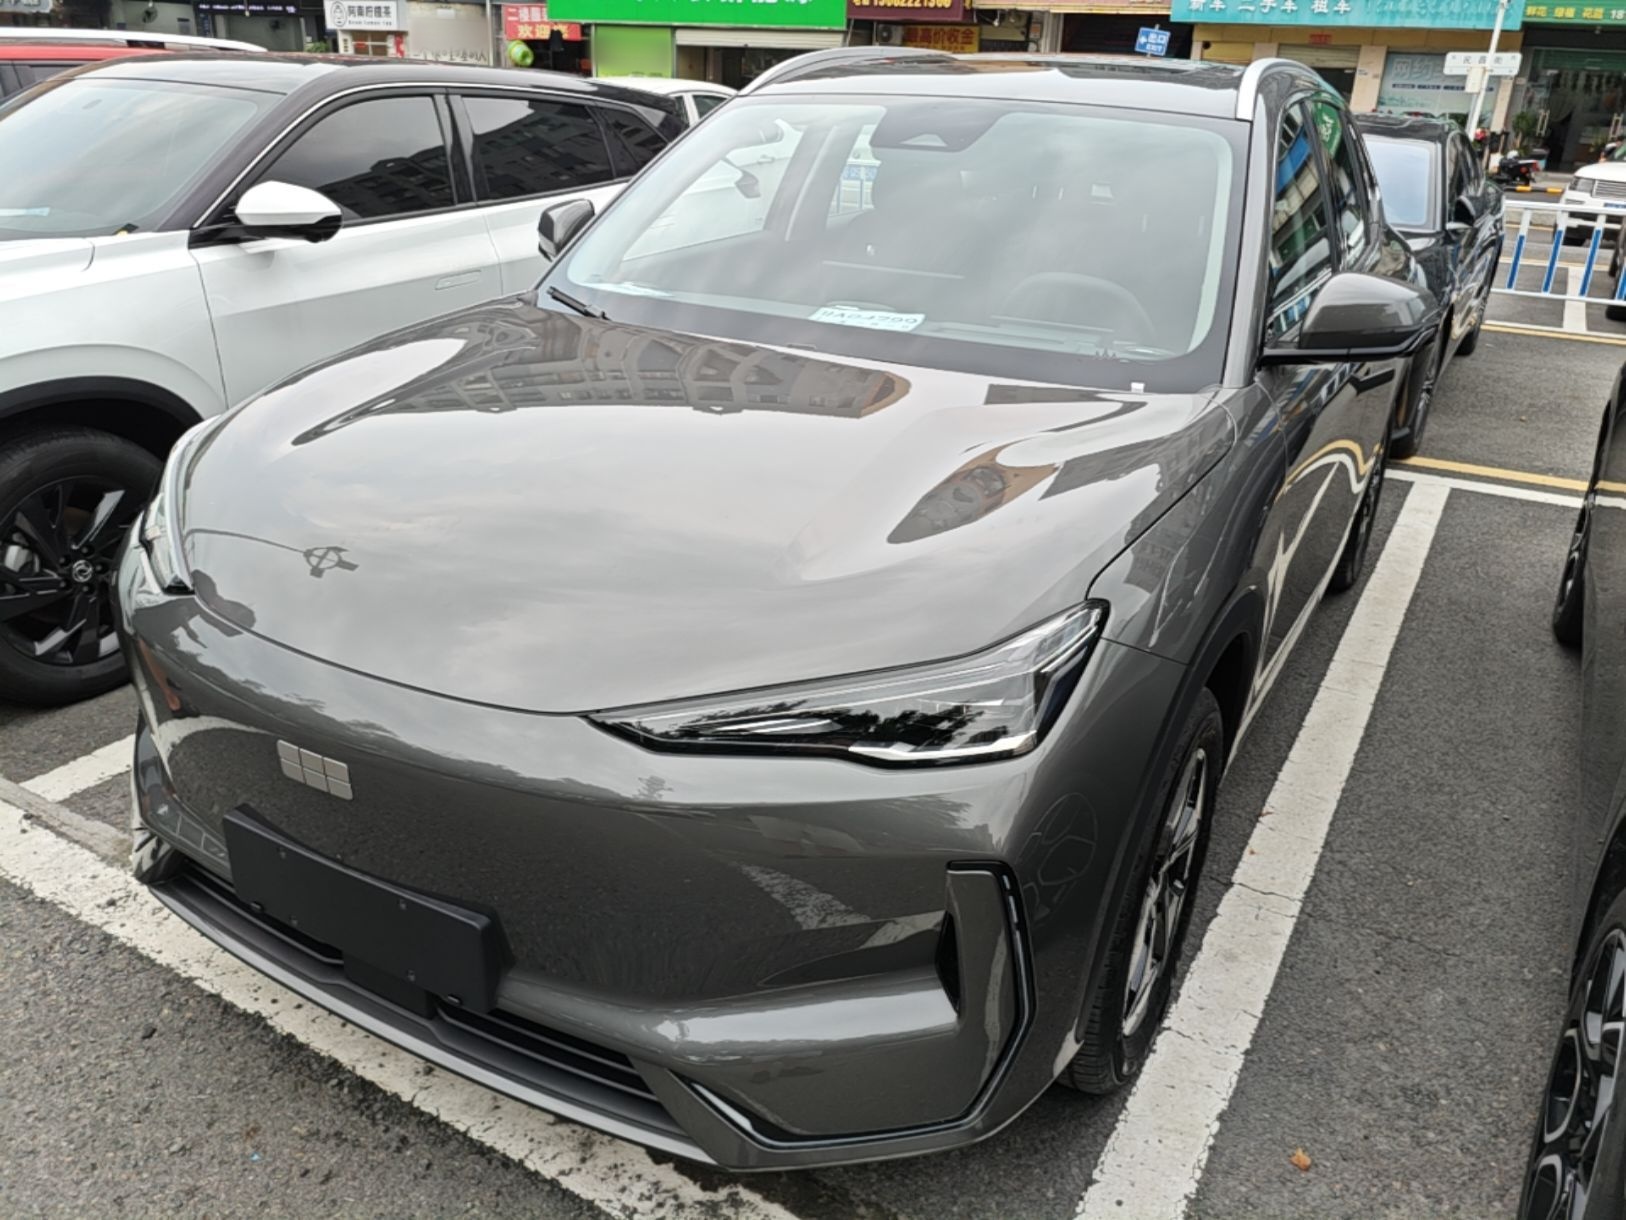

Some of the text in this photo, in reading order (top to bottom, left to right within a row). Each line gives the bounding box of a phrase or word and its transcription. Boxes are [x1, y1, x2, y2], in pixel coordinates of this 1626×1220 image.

[1238, 0, 1298, 13] 二手车
[1311, 0, 1351, 14] 租车
